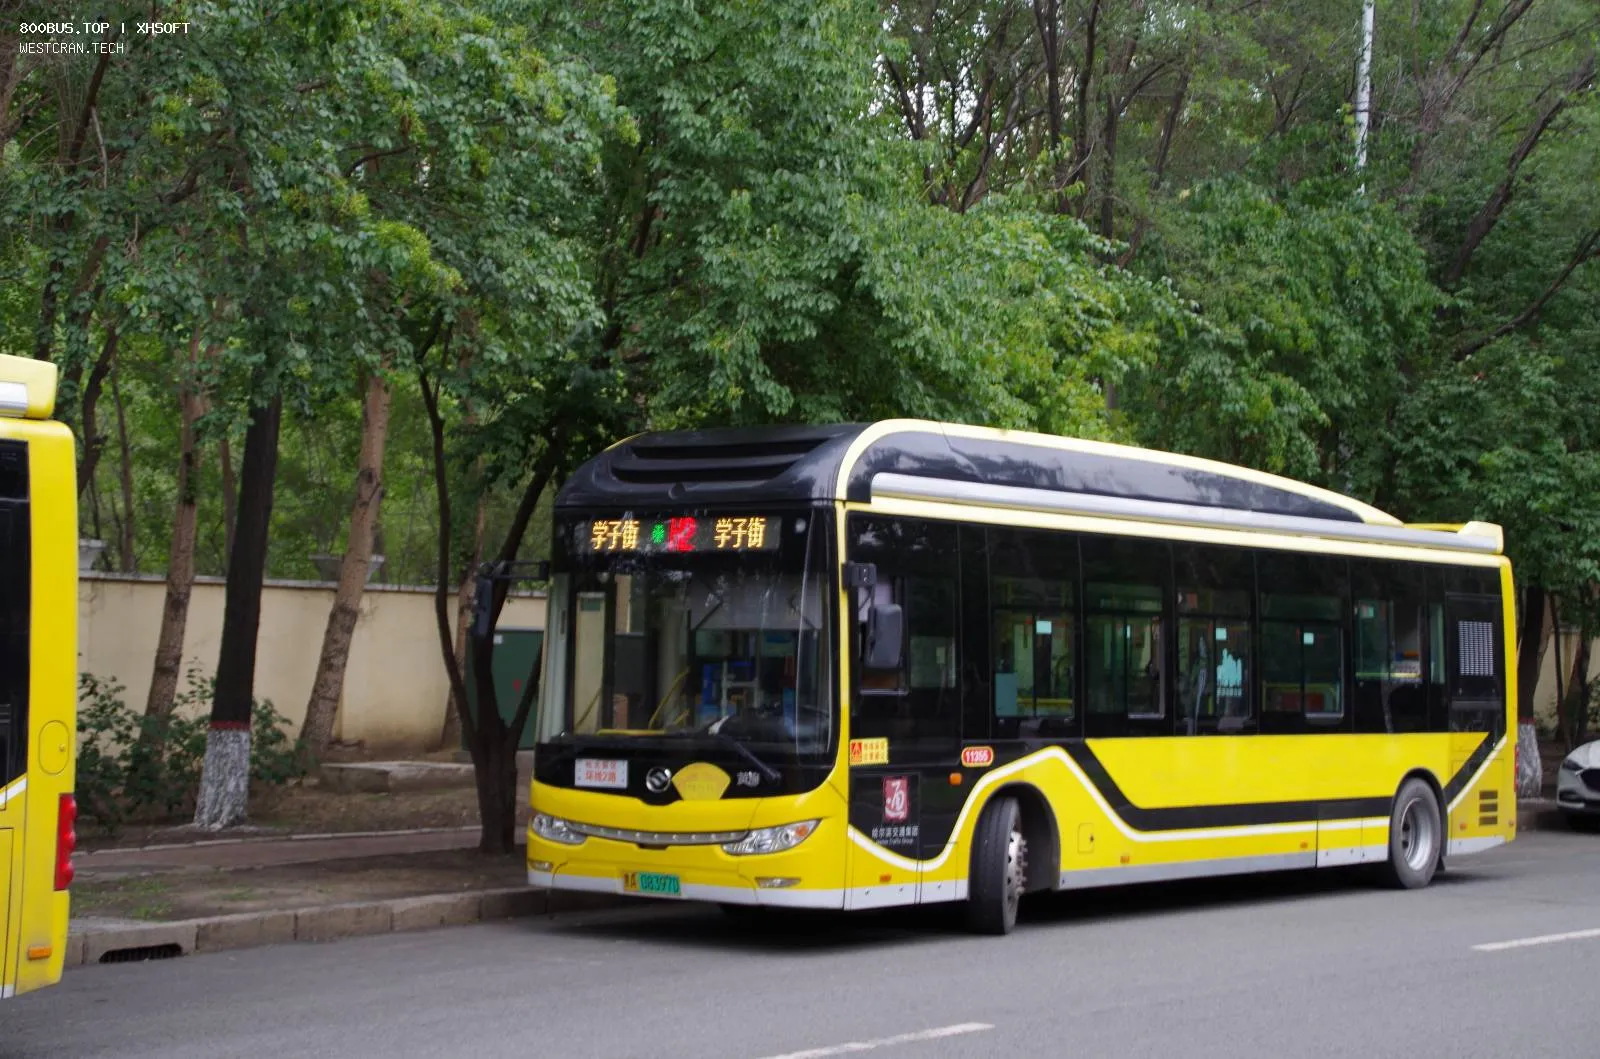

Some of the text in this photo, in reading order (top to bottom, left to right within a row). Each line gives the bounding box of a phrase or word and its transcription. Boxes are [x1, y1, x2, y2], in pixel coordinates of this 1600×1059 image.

[591, 520, 641, 550] 学子街
[714, 517, 766, 548] 学子街
